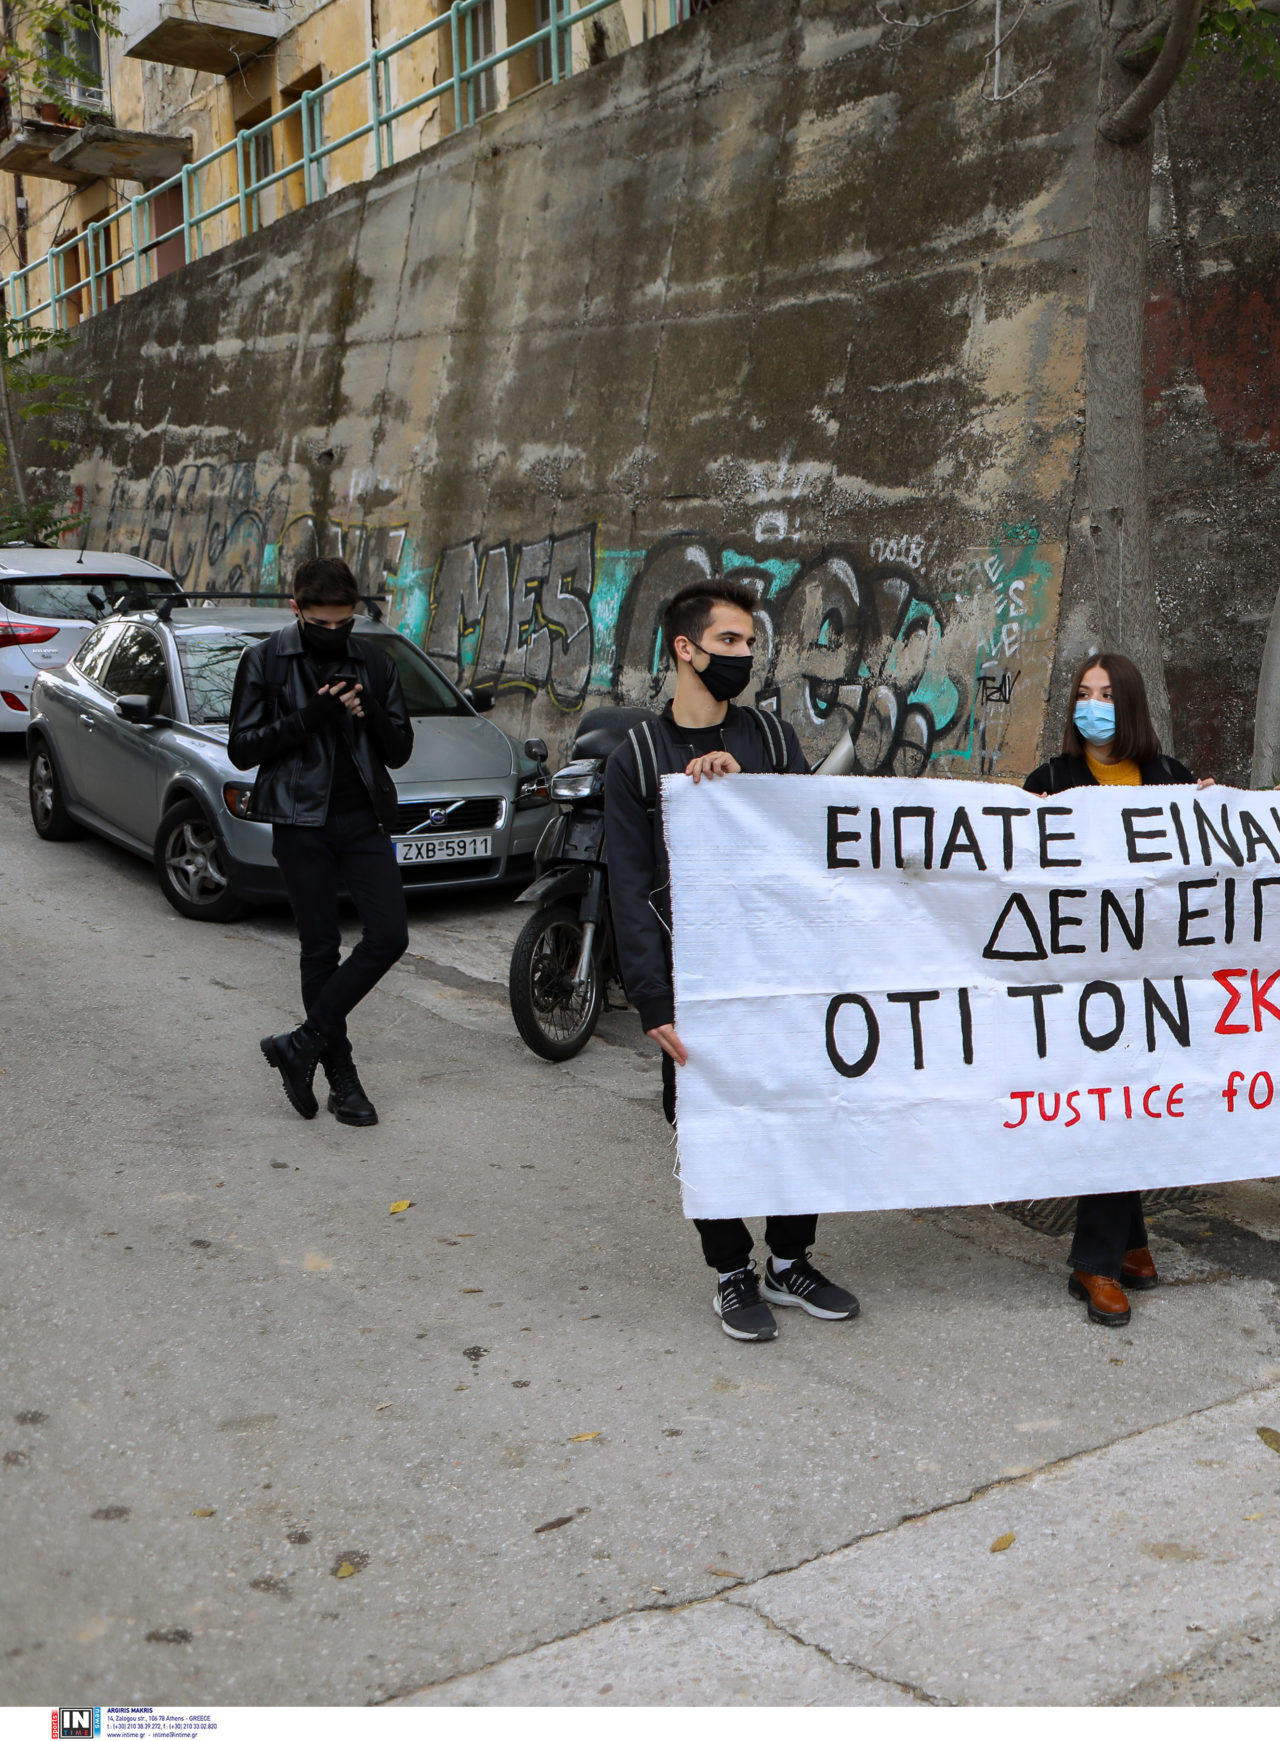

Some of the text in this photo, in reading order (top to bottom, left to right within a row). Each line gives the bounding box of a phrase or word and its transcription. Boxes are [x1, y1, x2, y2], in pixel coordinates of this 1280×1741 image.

[402, 837, 489, 861] ZXB-5911
[827, 806, 1082, 871] ΕΙΠΑΤΕ
[983, 889, 1144, 961] ΔΕΝ
[825, 988, 973, 1078] ΟΤΙ
[1007, 975, 1191, 1059] ΤΟΝ
[1004, 1083, 1184, 1128] JUSTICE
